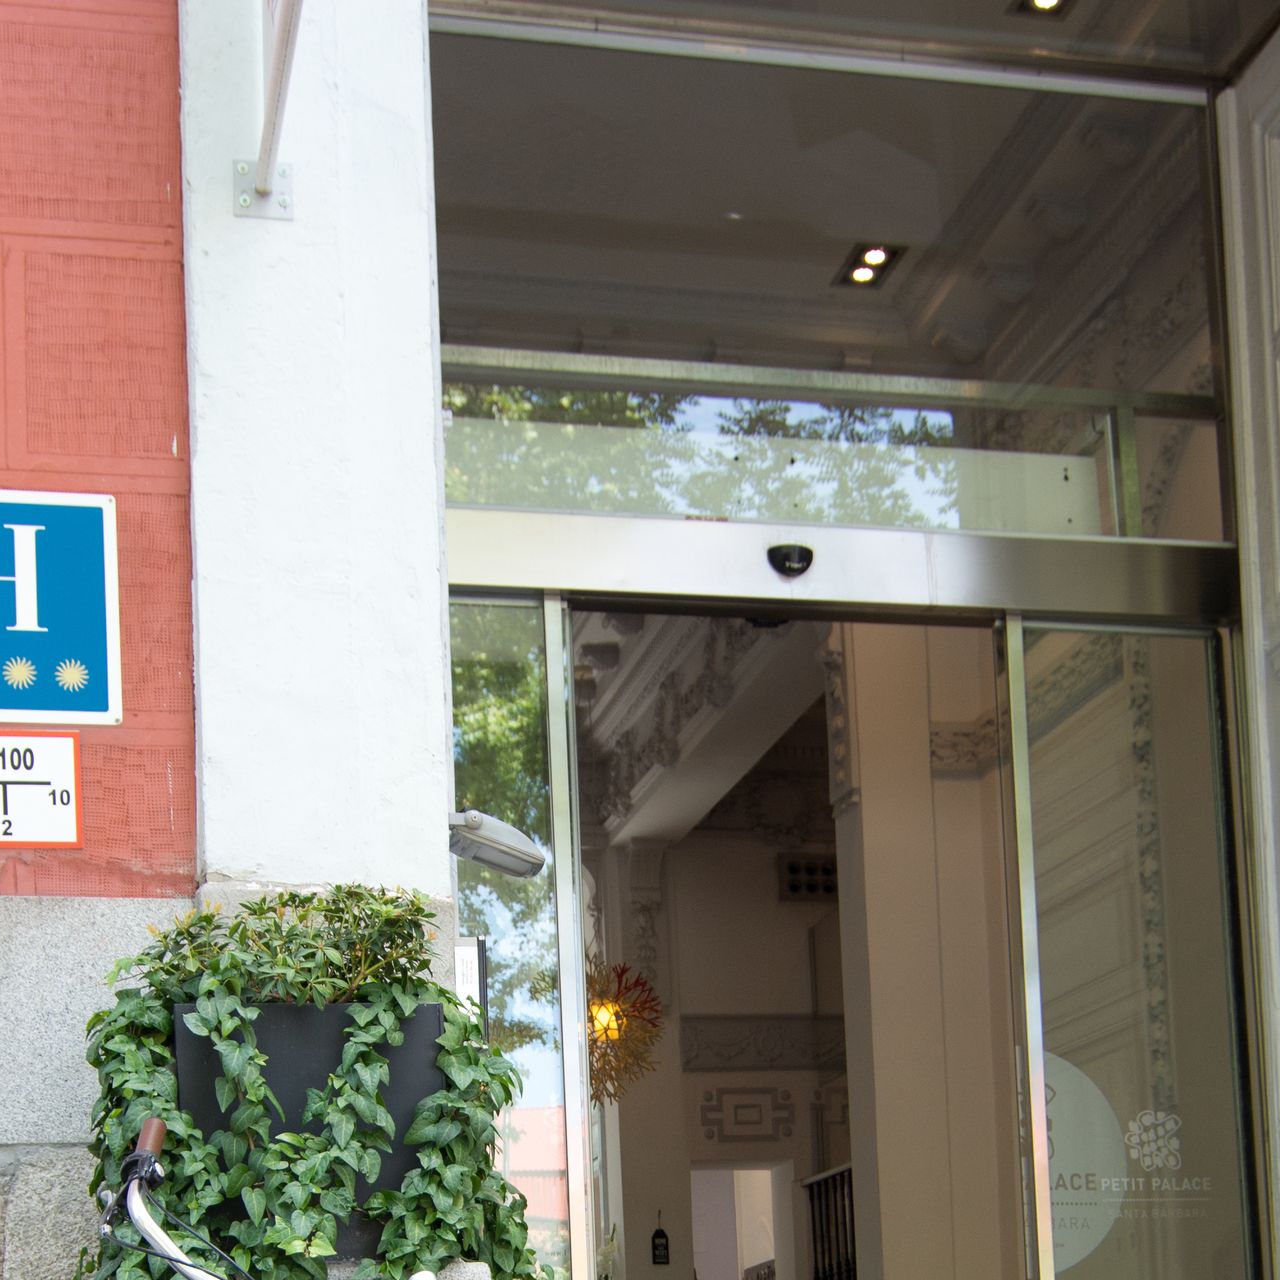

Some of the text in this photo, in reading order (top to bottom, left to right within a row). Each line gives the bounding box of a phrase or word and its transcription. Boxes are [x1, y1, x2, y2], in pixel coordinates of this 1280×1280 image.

[48, 788, 71, 806] 10
[1, 818, 13, 836] 2
[1100, 1176, 1213, 1192] PETIT PALACE
